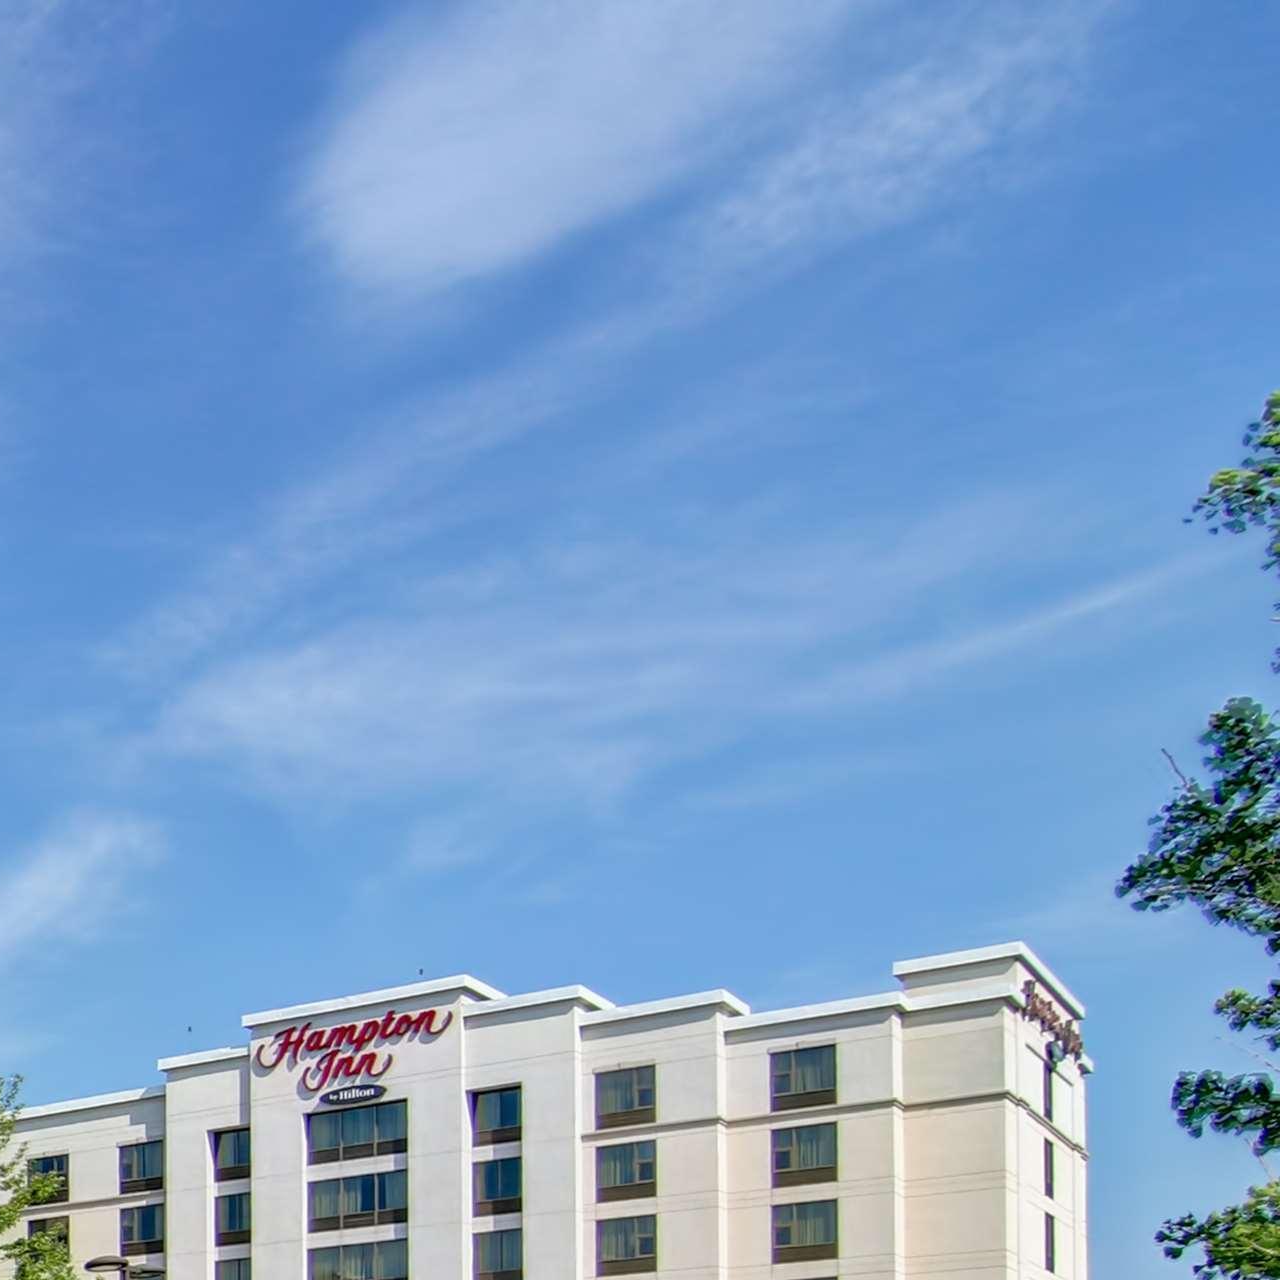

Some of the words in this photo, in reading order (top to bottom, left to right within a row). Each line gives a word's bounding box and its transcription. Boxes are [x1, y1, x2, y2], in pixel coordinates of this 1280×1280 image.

[256, 1010, 453, 1068] Hampton
[303, 1050, 393, 1092] Inn
[339, 1087, 376, 1101] Hilton
